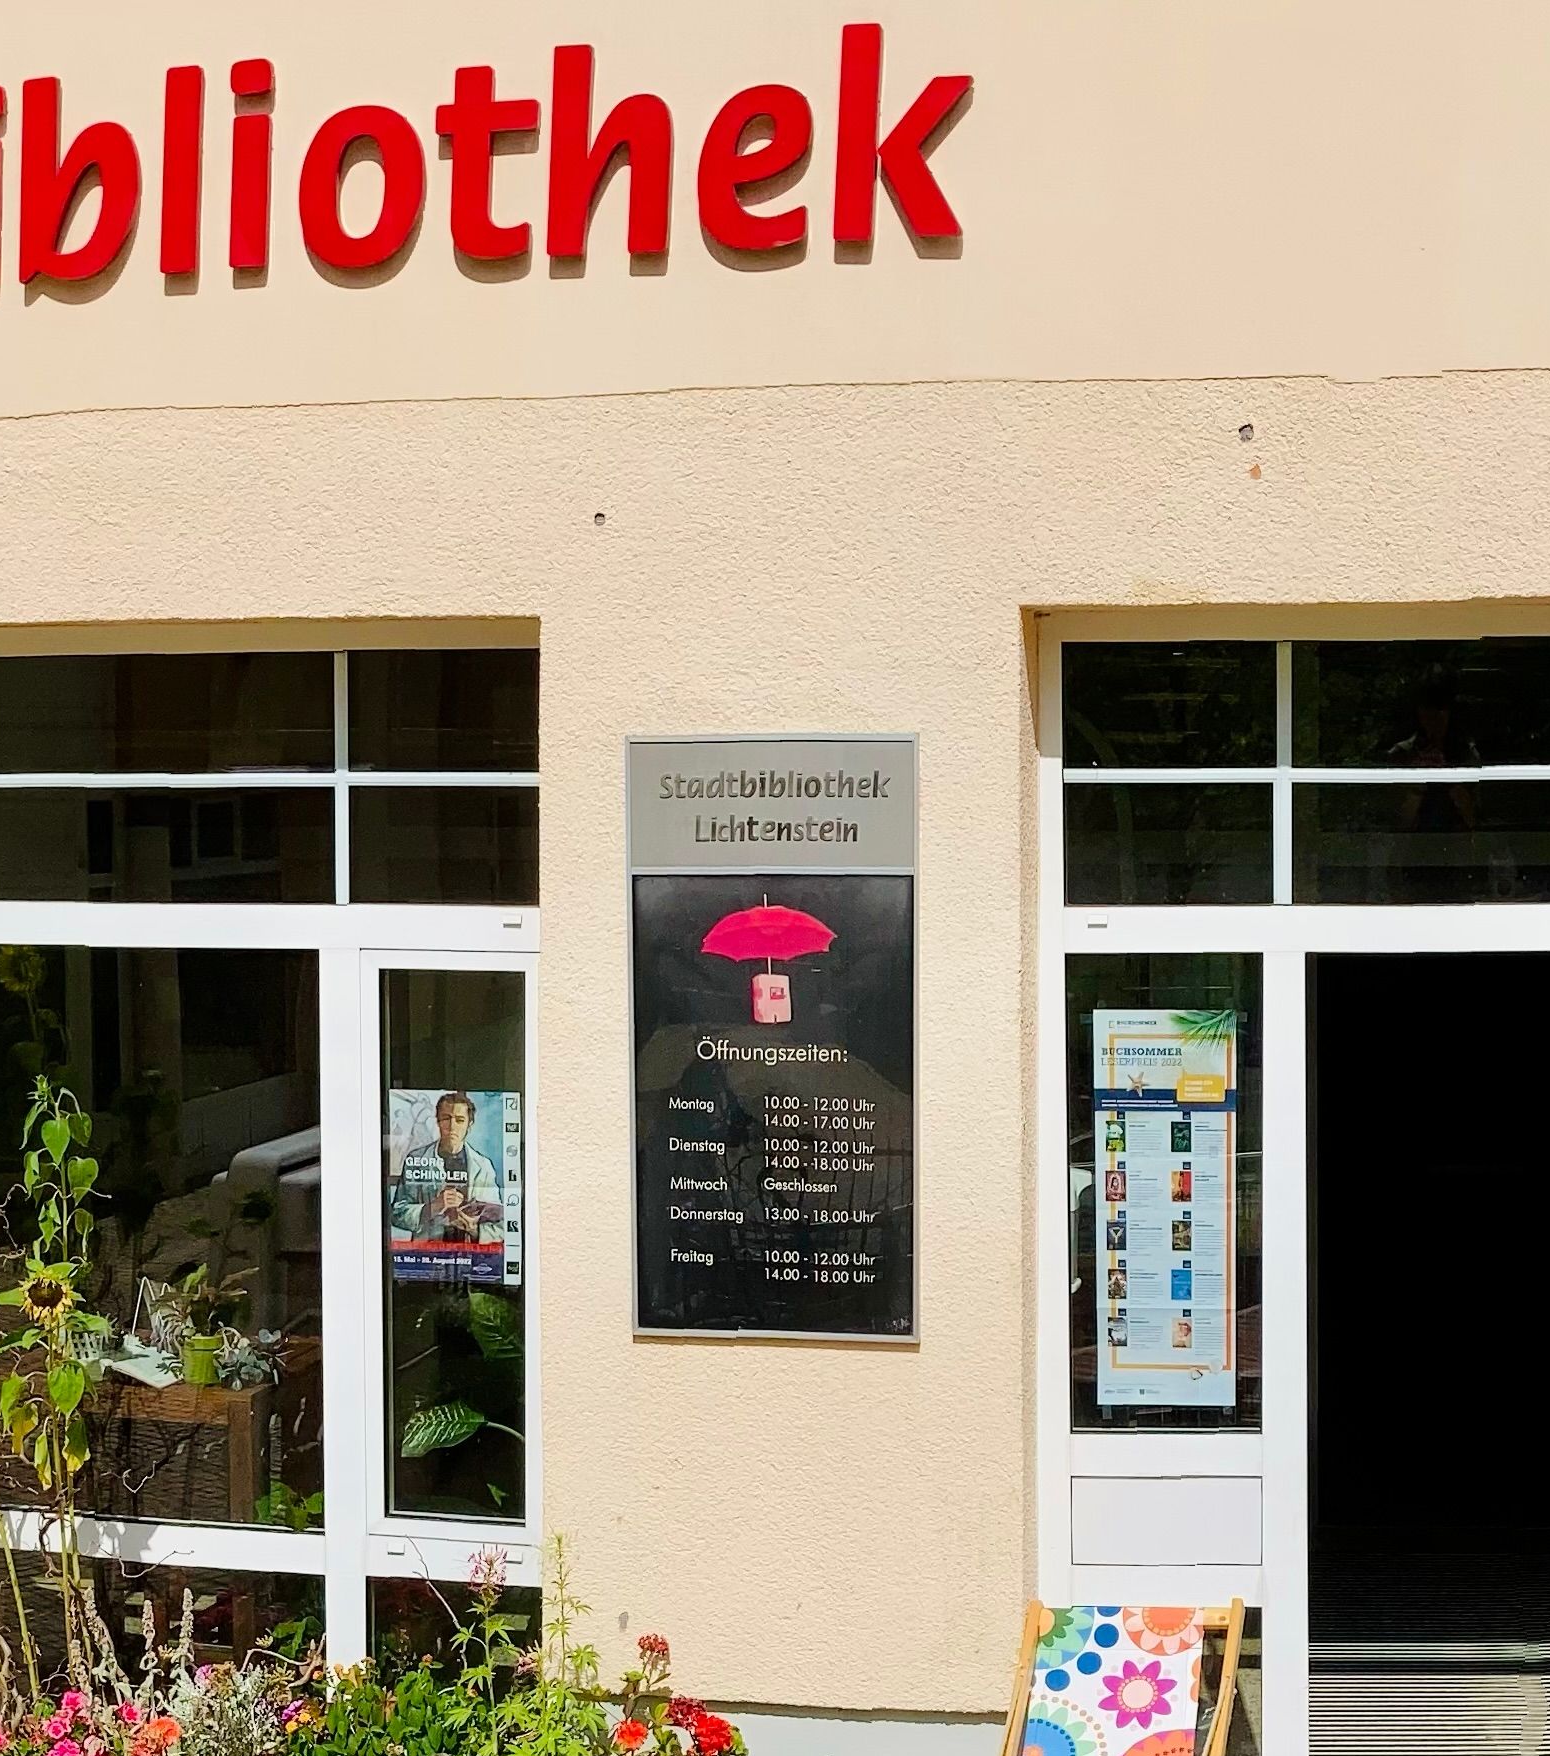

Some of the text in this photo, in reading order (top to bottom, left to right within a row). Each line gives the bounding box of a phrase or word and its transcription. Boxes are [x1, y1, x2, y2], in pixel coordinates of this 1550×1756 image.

[659, 770, 891, 799] Stadtbibliothek
[694, 815, 859, 843] Lichtenstein
[696, 1035, 848, 1066] Öffnungszeiten:
[1101, 1047, 1183, 1056] BUCHSOMMER
[1101, 1057, 1183, 1067] LESERPREIS 2022
[668, 1096, 715, 1113] Montag
[764, 1096, 800, 1110] 10.00
[813, 1097, 849, 1112] 12.00
[853, 1098, 876, 1112] Uhr
[764, 1114, 800, 1128] 14.00
[813, 1116, 849, 1130] 17.00
[853, 1116, 876, 1130] Uhr
[669, 1137, 725, 1155] Dienstag
[764, 1138, 800, 1152] 10.00
[813, 1140, 849, 1154] 12.00
[853, 1141, 876, 1155] Uhr
[405, 1156, 445, 1167] GEORG
[764, 1156, 800, 1169] 14.00
[813, 1158, 849, 1171] 18.00
[853, 1158, 876, 1171] Uhr
[405, 1169, 468, 1181] SCHINDLER
[670, 1176, 838, 1193] Mittwoch Geschlossen
[670, 1206, 744, 1223] Donnerstag
[764, 1207, 800, 1221] 13.00
[813, 1209, 849, 1223] 18.00
[853, 1210, 876, 1223] Uhr
[670, 1249, 714, 1265] Freitag
[764, 1250, 800, 1263] 10.00
[813, 1252, 849, 1266] 12.00
[853, 1253, 876, 1266] Uhr
[764, 1268, 800, 1281] 14.00
[813, 1270, 849, 1284] 18.00
[853, 1271, 876, 1284] Uhr
